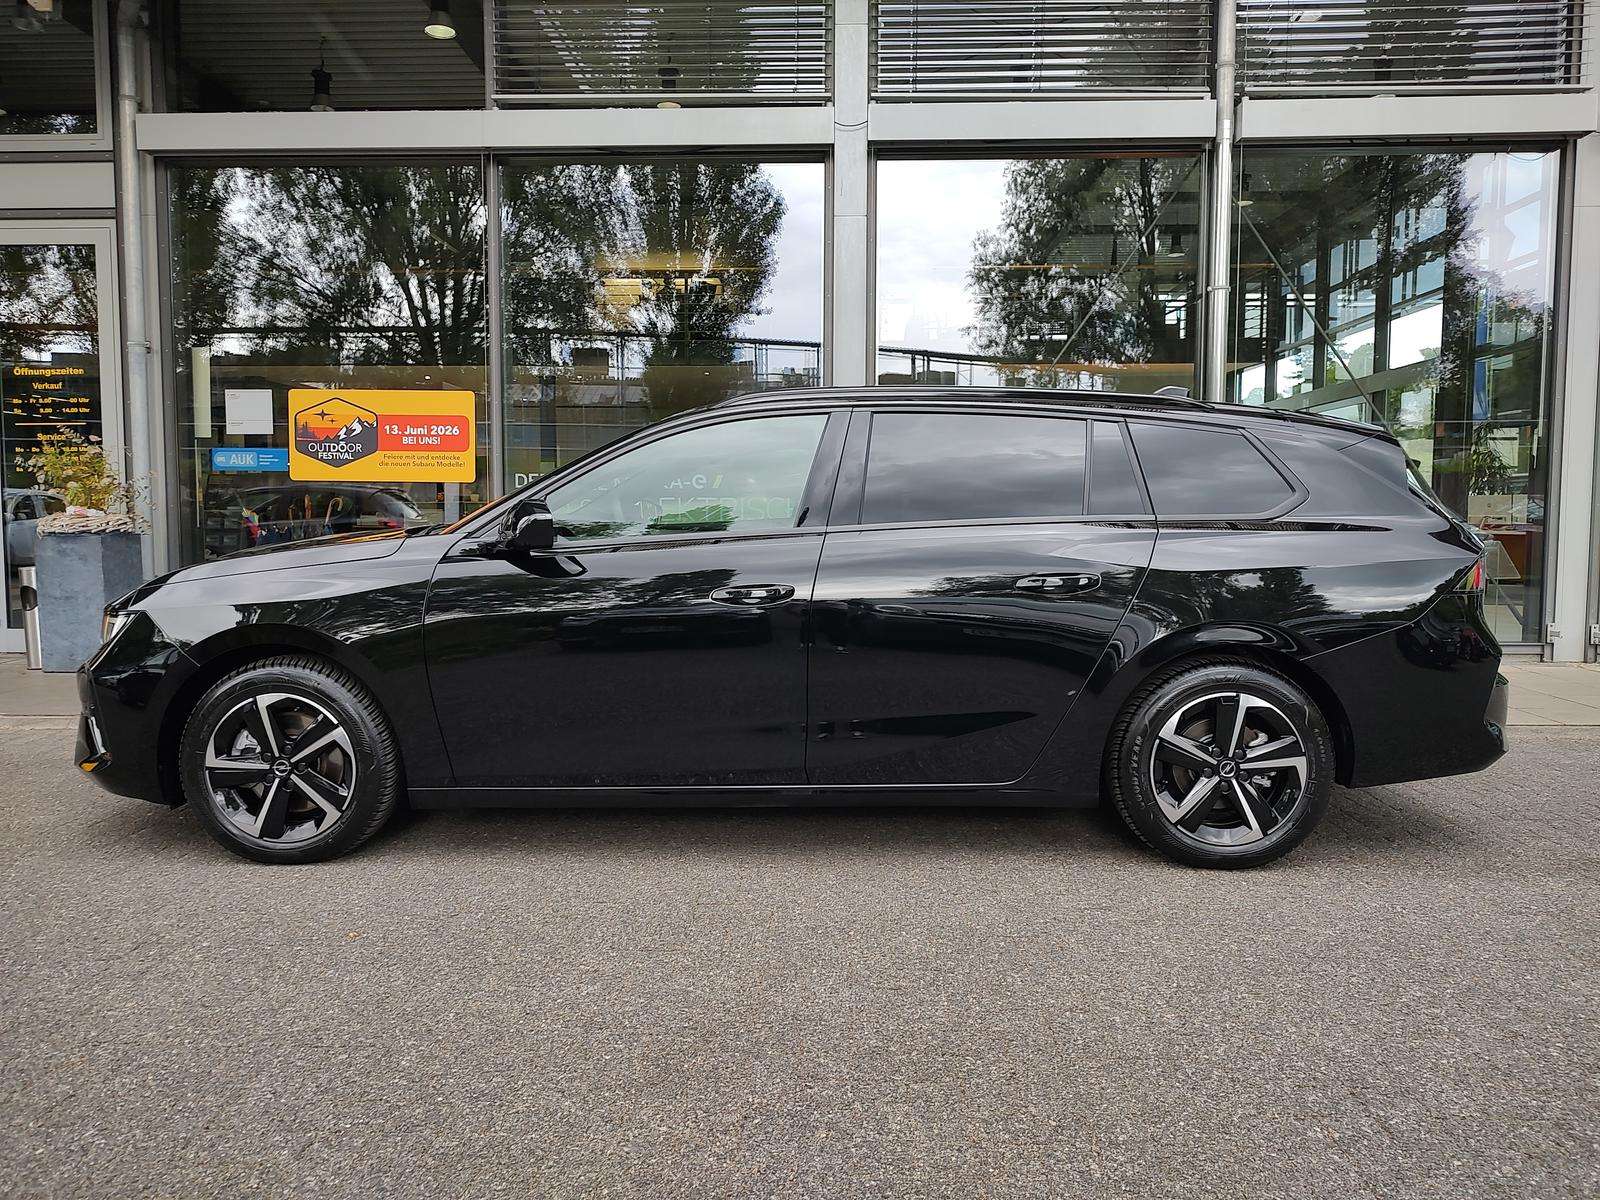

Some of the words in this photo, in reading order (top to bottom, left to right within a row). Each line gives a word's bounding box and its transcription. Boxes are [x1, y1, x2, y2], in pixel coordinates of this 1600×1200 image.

[13, 366, 85, 377] Öffnungszeiten
[32, 381, 62, 390] Verkauf
[384, 424, 402, 435] 13.
[404, 424, 428, 435] Juni
[430, 425, 460, 436] 2026
[37, 433, 66, 441] Service
[402, 436, 417, 445] BEI
[419, 436, 441, 445] UNS!
[318, 452, 354, 460] FESTIVAL
[383, 453, 403, 461] Feiere
[405, 453, 416, 461] mit
[417, 453, 430, 461] und
[431, 454, 461, 462] entdecke
[412, 460, 435, 468] Subaru
[436, 460, 466, 468] Modelle!
[514, 473, 544, 488] DE
